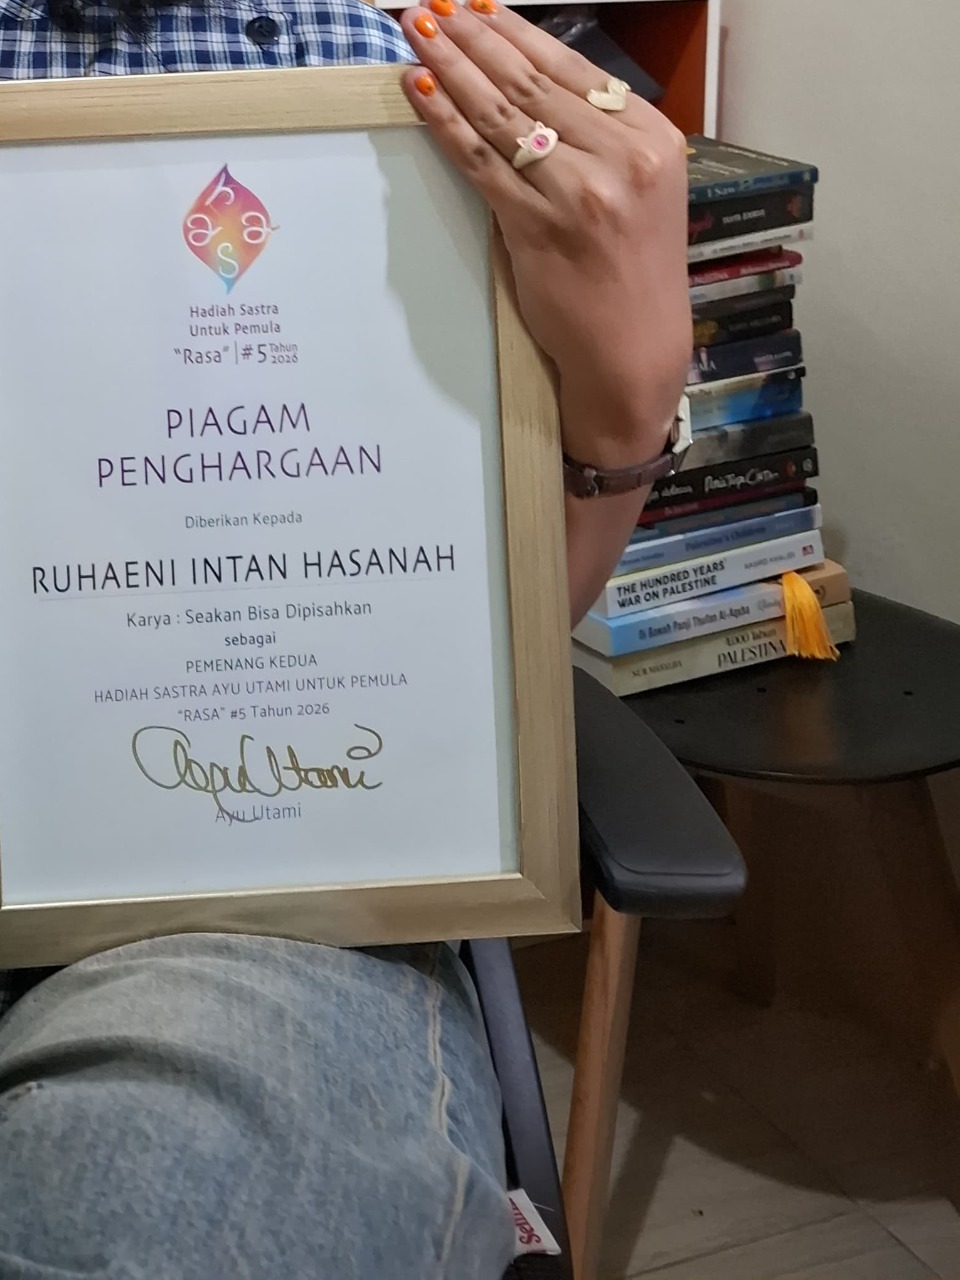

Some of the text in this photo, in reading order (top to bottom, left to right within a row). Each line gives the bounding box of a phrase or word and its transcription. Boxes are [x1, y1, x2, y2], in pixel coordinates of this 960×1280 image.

[189, 303, 279, 318] Hadiah Sastra
[189, 320, 281, 337] Untuk Pemula
[268, 342, 298, 354] Tahun
[271, 352, 299, 365] 2026
[166, 402, 311, 439] PIAGAM
[97, 444, 382, 488] PENGHARGAAN
[184, 510, 303, 529] Diberikan Kepada
[32, 544, 455, 594] RUHAENI INTAN HASANAH
[616, 584, 637, 597] THE
[640, 569, 690, 592] HUNDRED
[617, 575, 718, 609] WAR ON PALESTINE
[126, 612, 171, 630] Karya
[185, 607, 242, 625] Seakan
[247, 605, 280, 621] Bisa
[285, 600, 372, 622] Dipisahkan
[224, 632, 276, 649] sebagai
[186, 653, 318, 673] PEMENANG KEDUA
[94, 672, 408, 703] HADIAH SASTRA AYU UTAMI UNTUK PEMULA
[230, 707, 247, 721] #5
[249, 704, 293, 718] Tahun
[297, 702, 330, 716] 2026
[252, 802, 302, 821] Utami
